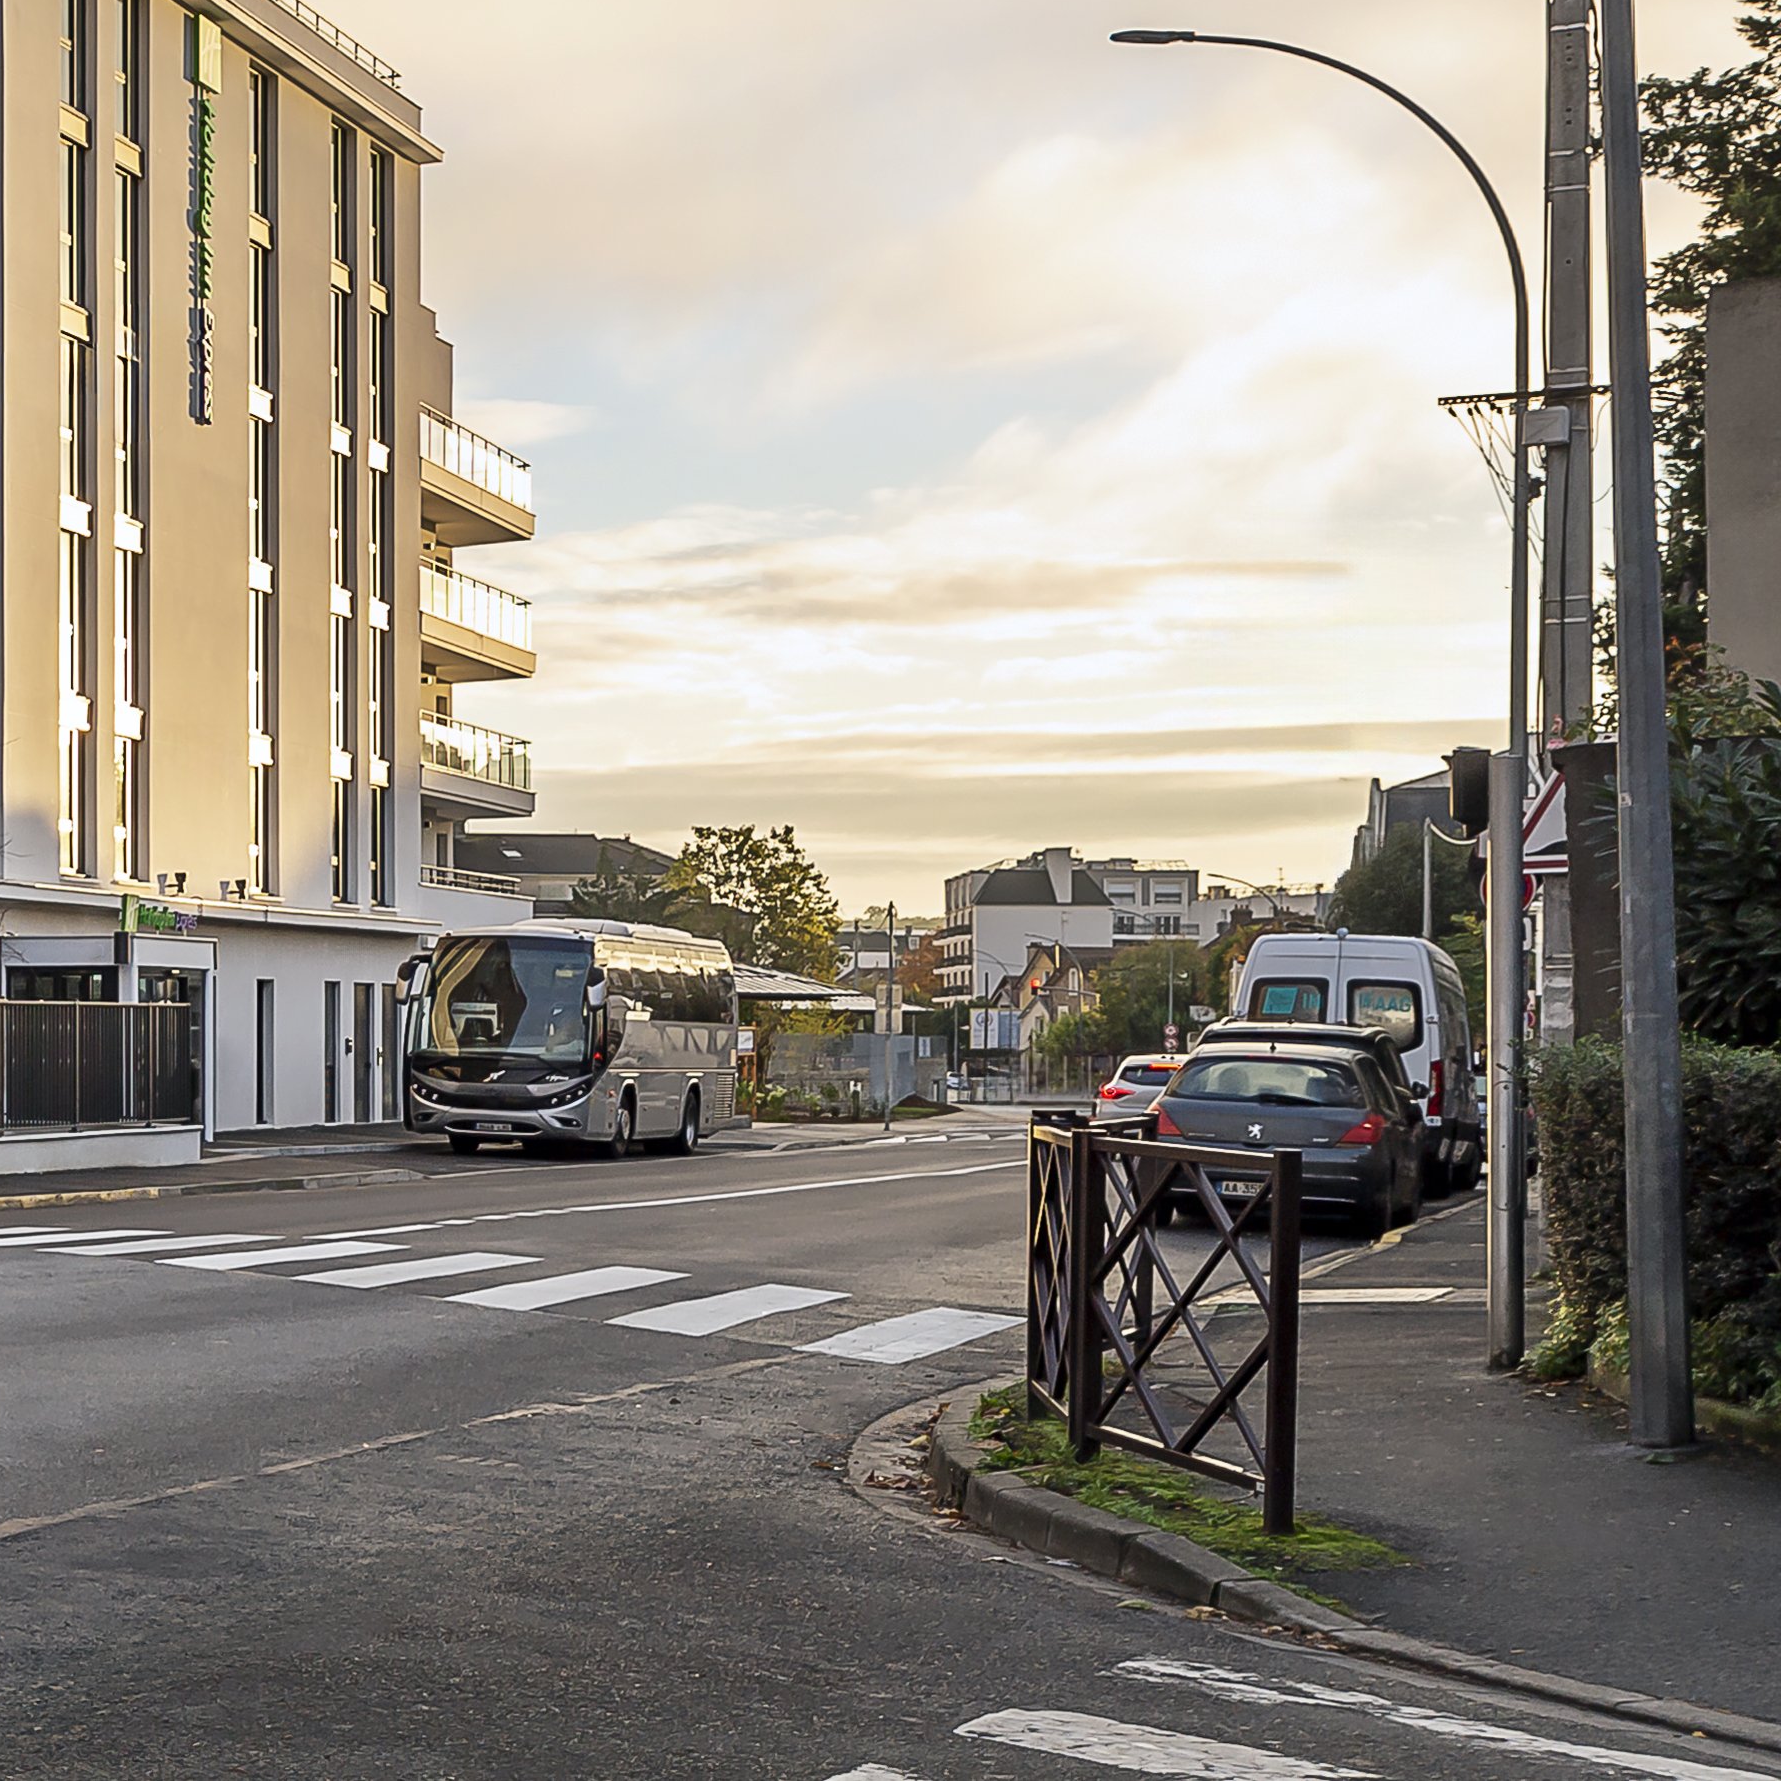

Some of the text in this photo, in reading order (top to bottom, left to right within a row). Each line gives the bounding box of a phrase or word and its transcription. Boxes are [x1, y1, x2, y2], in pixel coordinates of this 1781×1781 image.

[198, 98, 216, 424] Holiday Inn Express
